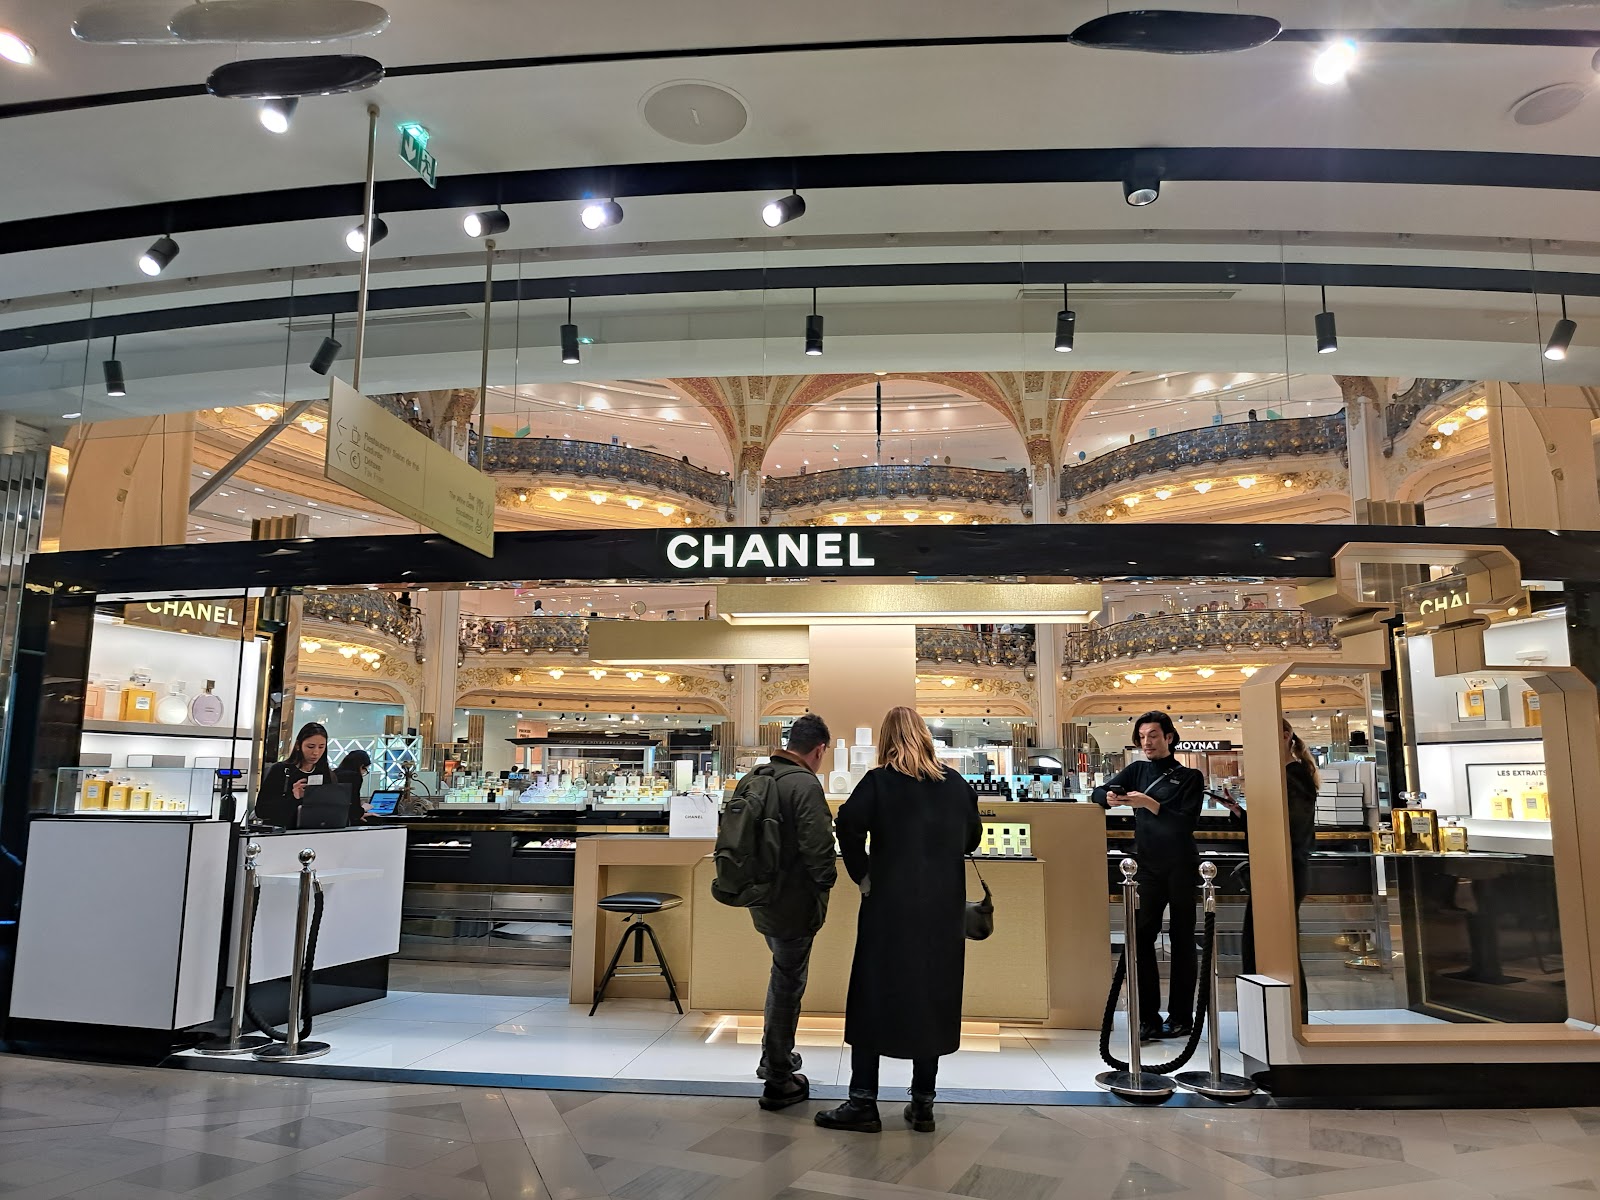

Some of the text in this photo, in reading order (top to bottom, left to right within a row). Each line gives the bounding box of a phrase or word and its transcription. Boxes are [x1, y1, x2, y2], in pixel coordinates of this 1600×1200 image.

[666, 532, 875, 569] CHANEL
[146, 600, 239, 626] CHANEL
[1419, 592, 1470, 616] CHA
[1174, 741, 1220, 750] MOYNAT
